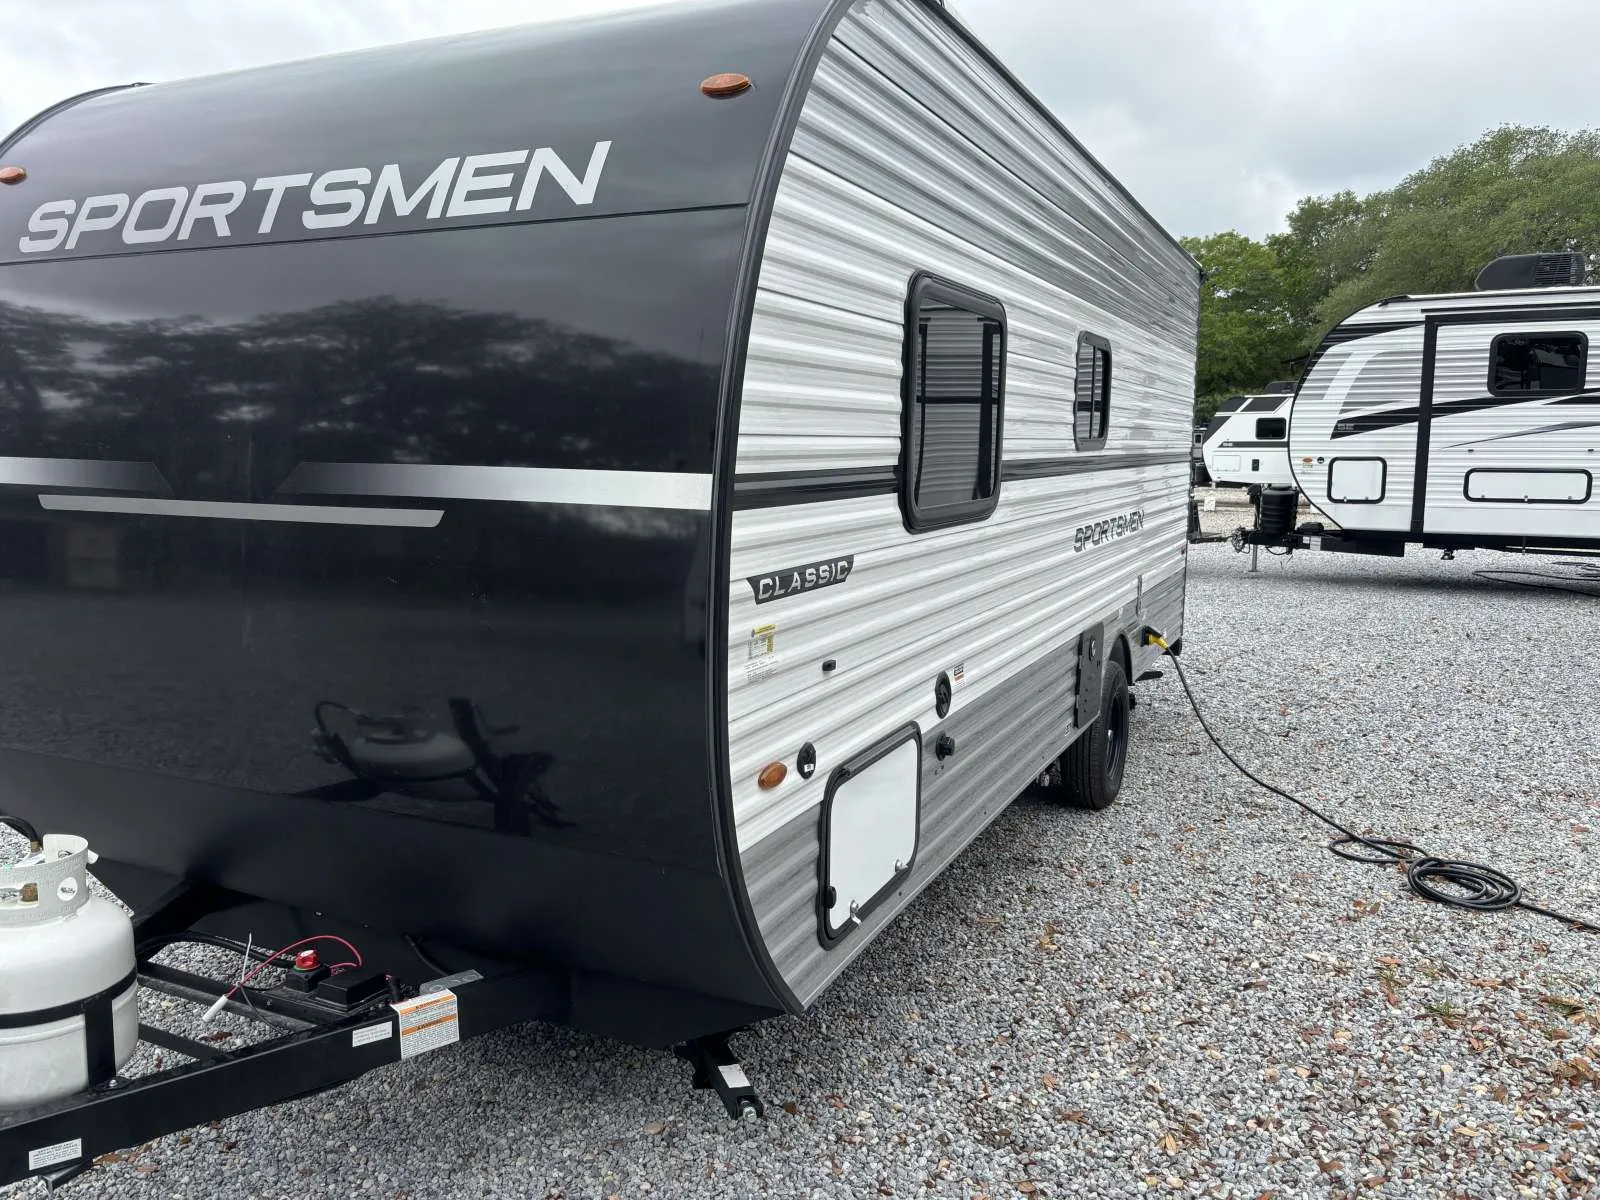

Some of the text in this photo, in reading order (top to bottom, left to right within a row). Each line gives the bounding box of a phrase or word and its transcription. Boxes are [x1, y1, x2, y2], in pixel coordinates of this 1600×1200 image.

[19, 140, 612, 253] SPORTSMEN
[1073, 509, 1145, 553] SPORTSMEN
[758, 560, 849, 600] CLASSIC
